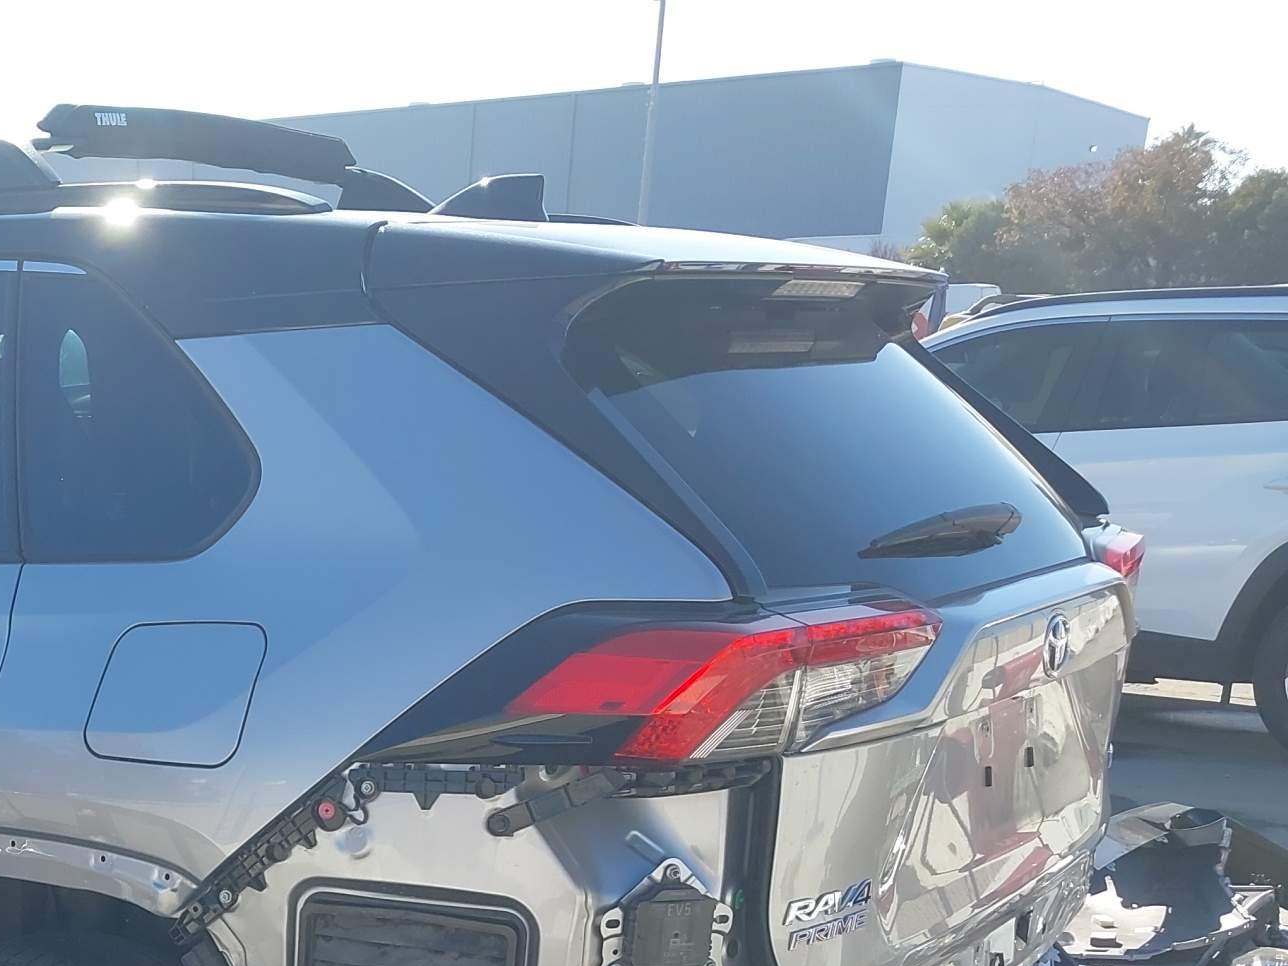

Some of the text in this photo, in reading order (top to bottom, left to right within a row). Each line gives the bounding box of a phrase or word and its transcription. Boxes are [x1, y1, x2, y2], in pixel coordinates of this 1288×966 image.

[94, 112, 128, 126] THULE
[782, 879, 872, 926] RAV4
[787, 908, 869, 951] PRIME
